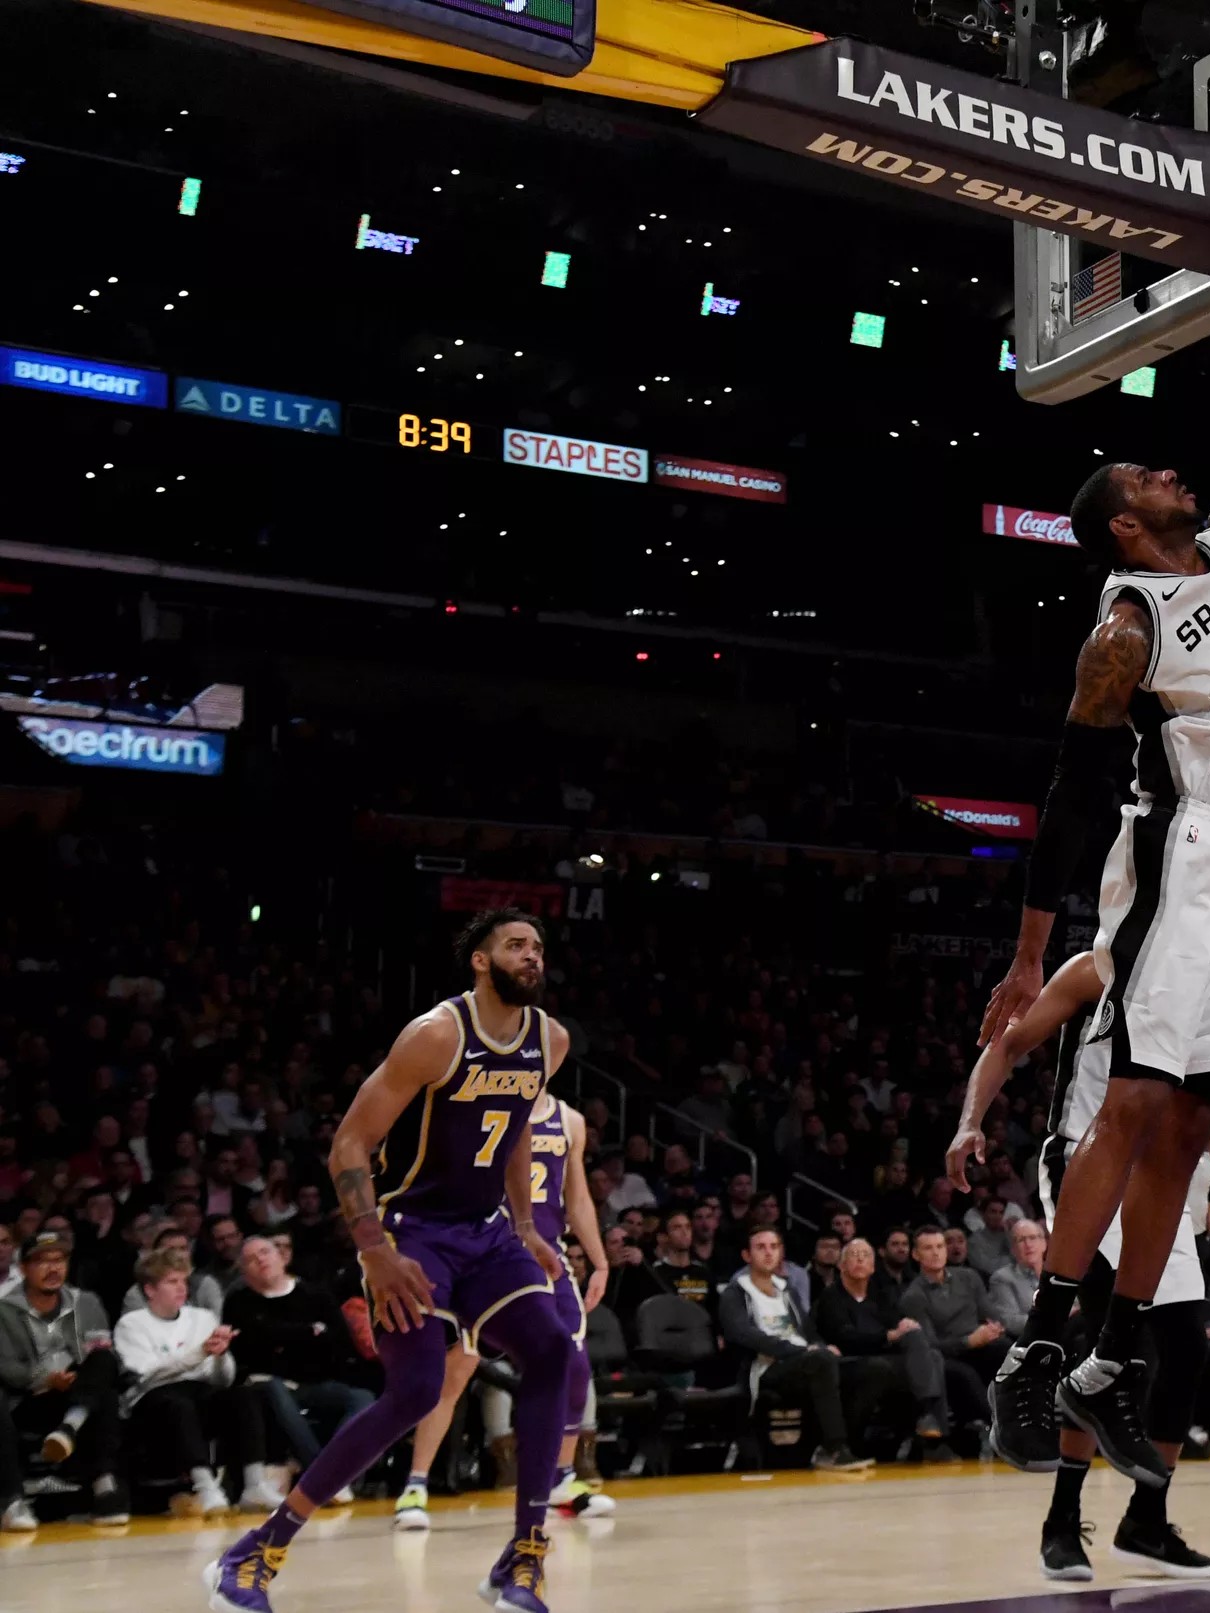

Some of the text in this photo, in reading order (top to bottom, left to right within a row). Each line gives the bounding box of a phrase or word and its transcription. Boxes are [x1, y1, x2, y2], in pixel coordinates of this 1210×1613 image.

[837, 57, 1207, 197] LAKERS.COM
[805, 132, 1184, 250] LAKERS.COM
[14, 360, 141, 397] BUD LIGHT
[219, 391, 337, 429] DELTA
[399, 413, 472, 454] 8:39
[508, 433, 642, 479] STAPLES
[665, 464, 690, 479] SAN
[943, 808, 1021, 827] McDonald's
[566, 886, 606, 921] LA
[448, 1063, 543, 1102] LAKERS
[473, 1110, 512, 1167] 7
